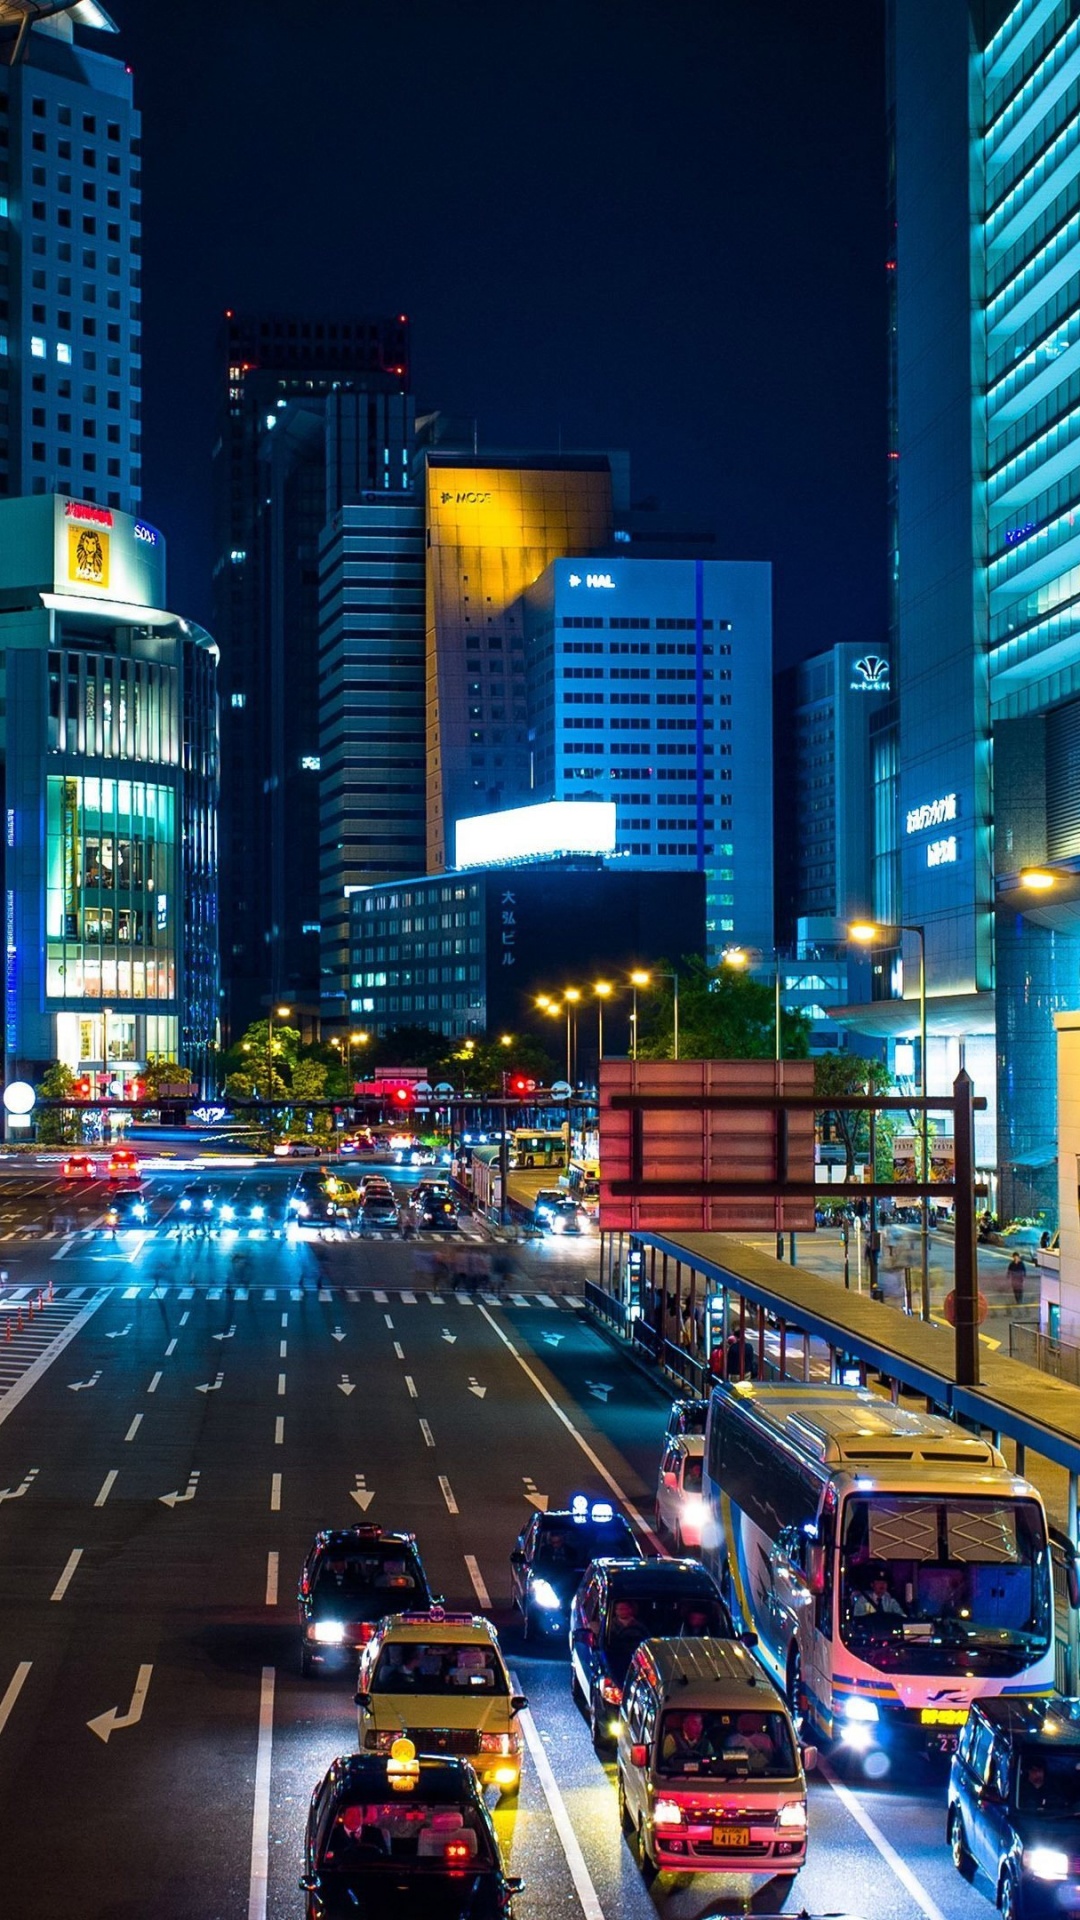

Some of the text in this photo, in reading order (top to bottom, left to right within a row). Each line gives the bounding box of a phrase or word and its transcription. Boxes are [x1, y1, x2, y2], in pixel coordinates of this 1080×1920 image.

[456, 492, 491, 503] MODE
[586, 574, 615, 588] HAL
[501, 890, 516, 965] 大弘ビル
[940, 1738, 958, 1751] 23
